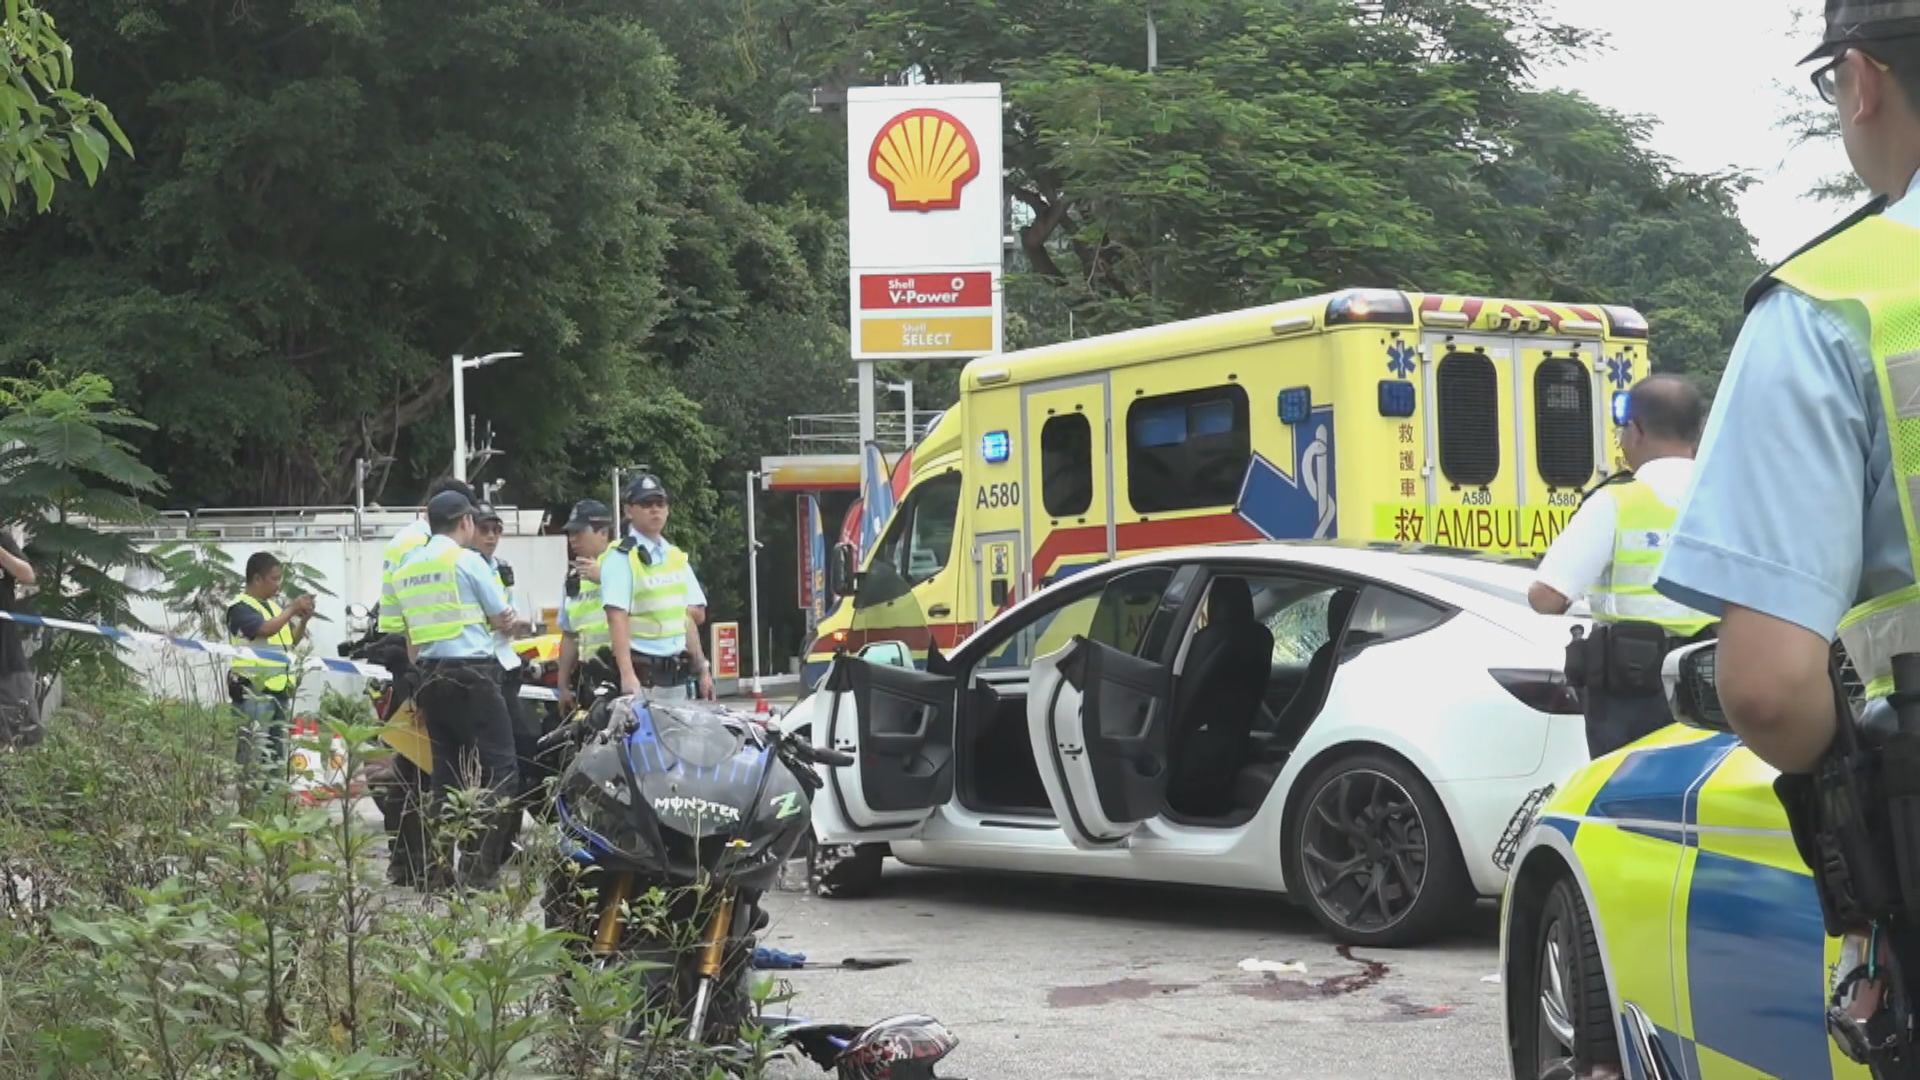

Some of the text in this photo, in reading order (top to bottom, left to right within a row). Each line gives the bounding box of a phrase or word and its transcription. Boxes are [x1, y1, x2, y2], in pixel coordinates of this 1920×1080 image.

[888, 279, 915, 290] Shell
[889, 290, 959, 304] V-Power
[902, 323, 927, 335] Shell
[902, 333, 952, 346] SELECT
[1398, 423, 1417, 498] 救護車
[976, 481, 1020, 510] A580
[1461, 491, 1492, 505] A580
[1547, 493, 1576, 506] A580
[1394, 508, 1424, 543] 救
